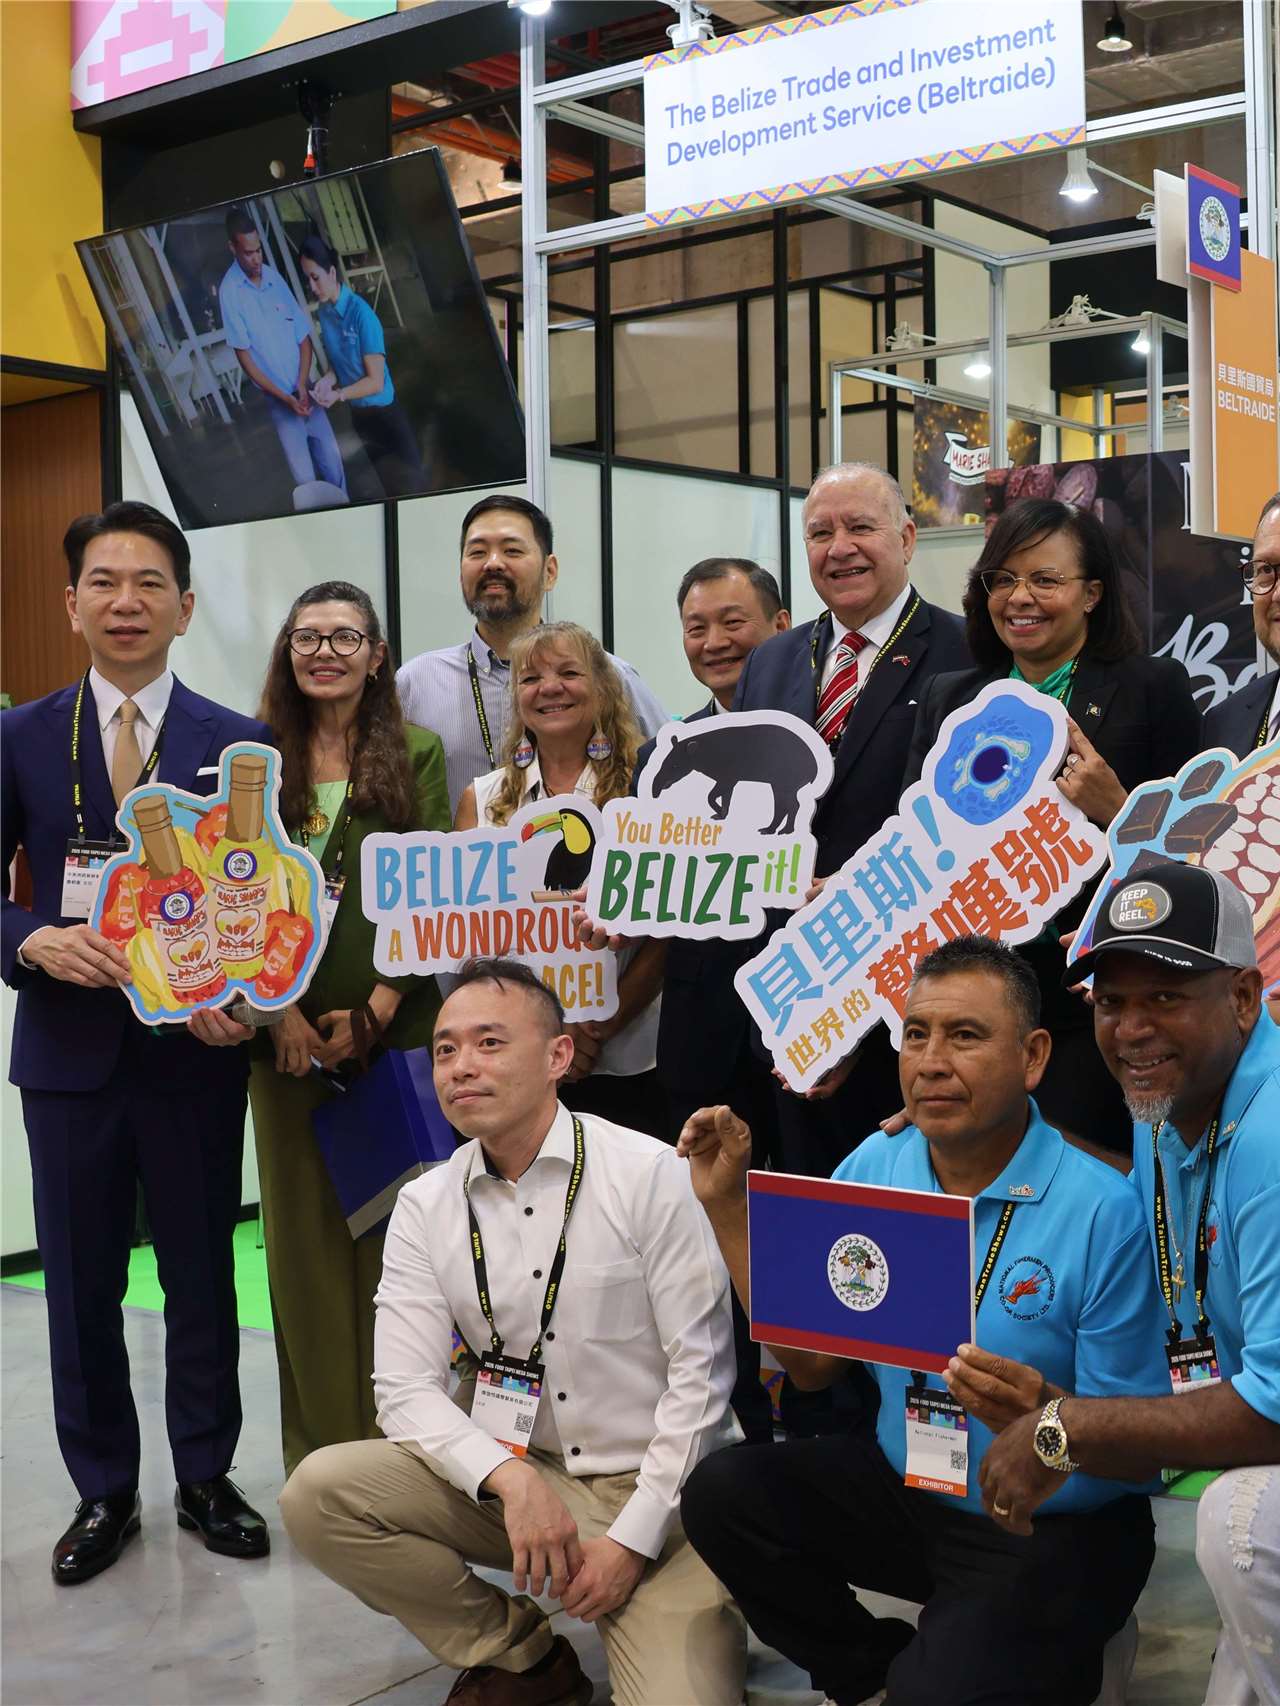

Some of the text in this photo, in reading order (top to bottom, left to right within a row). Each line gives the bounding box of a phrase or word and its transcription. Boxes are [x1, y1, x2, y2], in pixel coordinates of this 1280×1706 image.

[665, 18, 1057, 130] The Belize Trade and Investment
[667, 57, 1056, 166] Development Service (Beltraide)
[1217, 390, 1276, 423] BELTRAIDE
[615, 811, 723, 848] You Better
[376, 839, 519, 912] BELIZE
[598, 843, 802, 926] BELIZE it!
[1120, 888, 1149, 901] KEEP
[1118, 908, 1148, 923] REEL.
[1119, 900, 1129, 912] IT
[388, 905, 607, 962] A WONDROU
[541, 960, 606, 1009] ACE!
[784, 987, 873, 1077] 世界的
[1156, 1195, 1172, 1309] www.TaiwanTradeSho
[918, 1478, 955, 1493] EXHIBITOR
